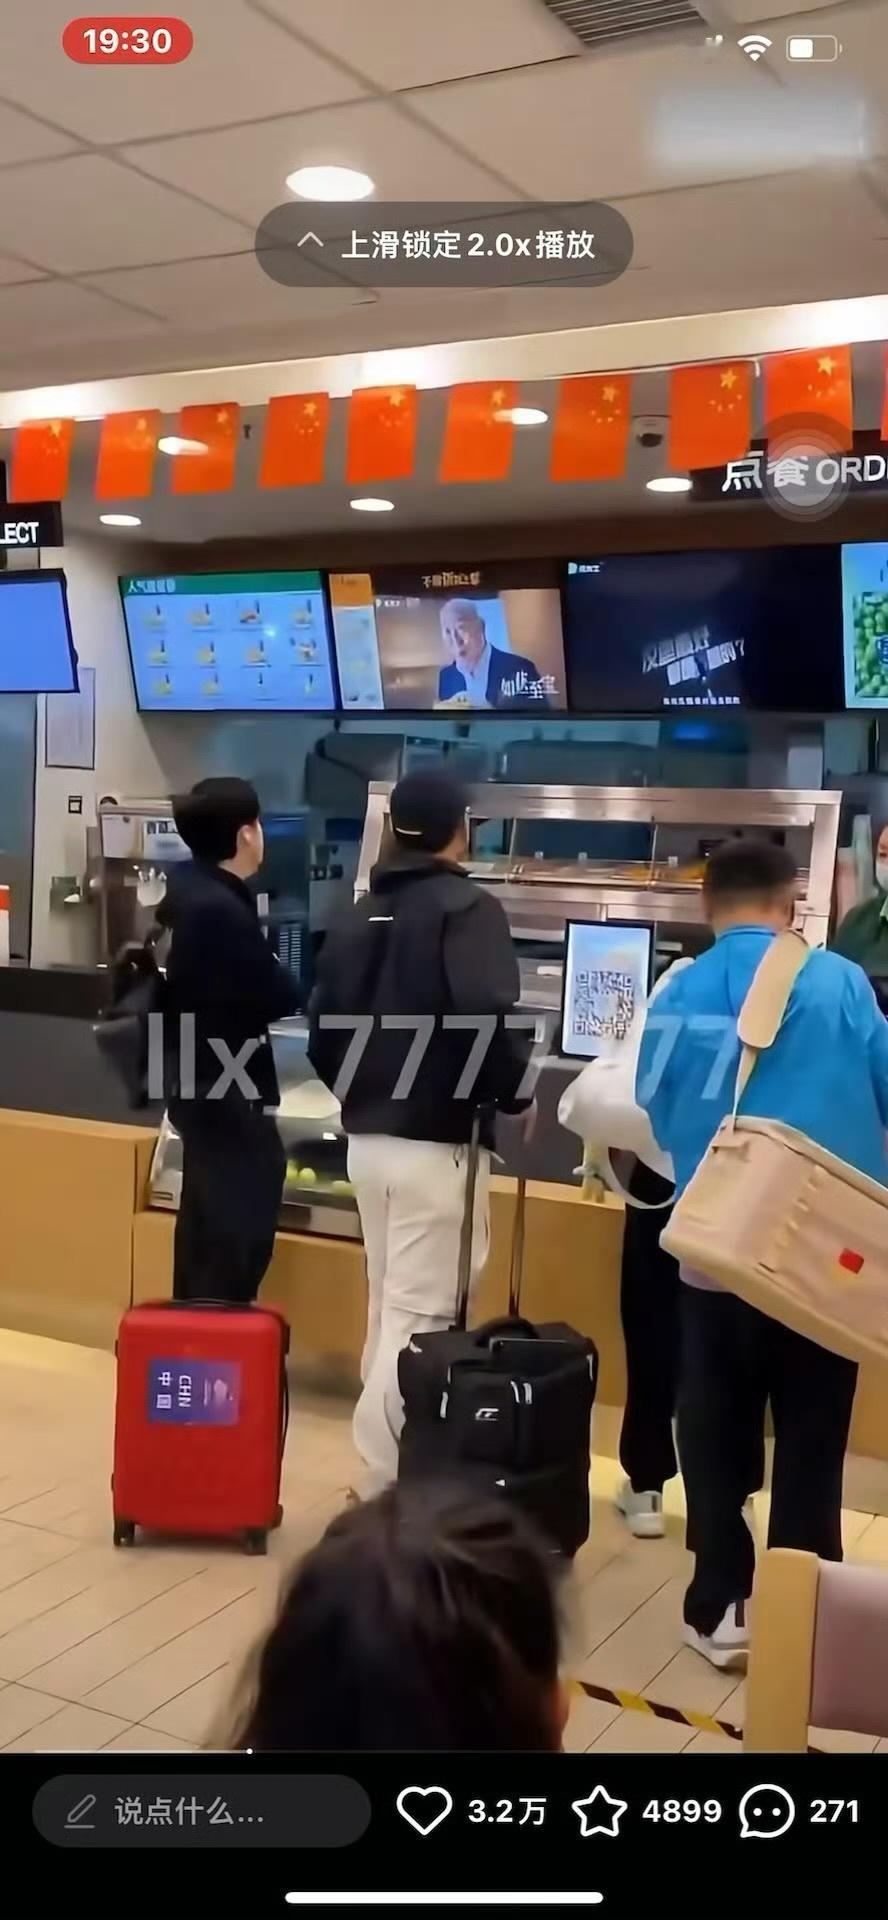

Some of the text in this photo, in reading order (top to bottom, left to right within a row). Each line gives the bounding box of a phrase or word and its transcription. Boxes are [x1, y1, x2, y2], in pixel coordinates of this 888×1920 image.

[815, 454, 888, 486] ORD
[156, 1371, 173, 1409] 中国
[178, 1374, 192, 1408] CHN
